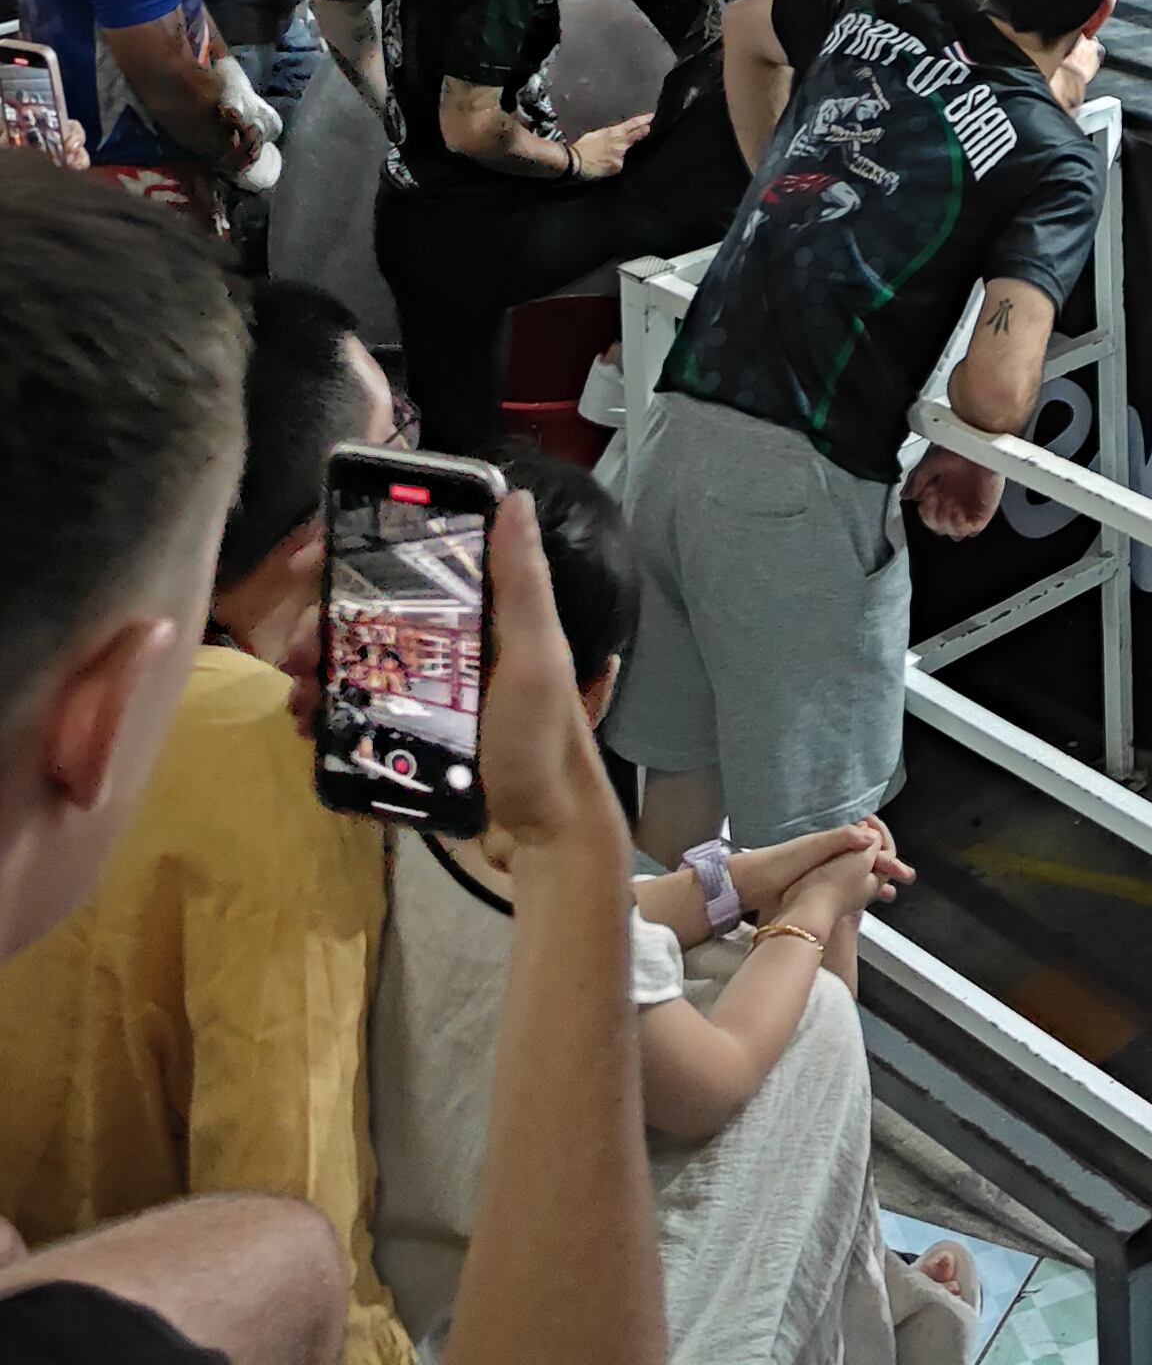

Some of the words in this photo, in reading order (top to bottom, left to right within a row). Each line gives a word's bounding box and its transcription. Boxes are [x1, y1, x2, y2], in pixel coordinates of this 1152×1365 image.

[819, 12, 928, 67] SPIRIT
[905, 55, 972, 98] OF
[943, 83, 1019, 182] SIAM
